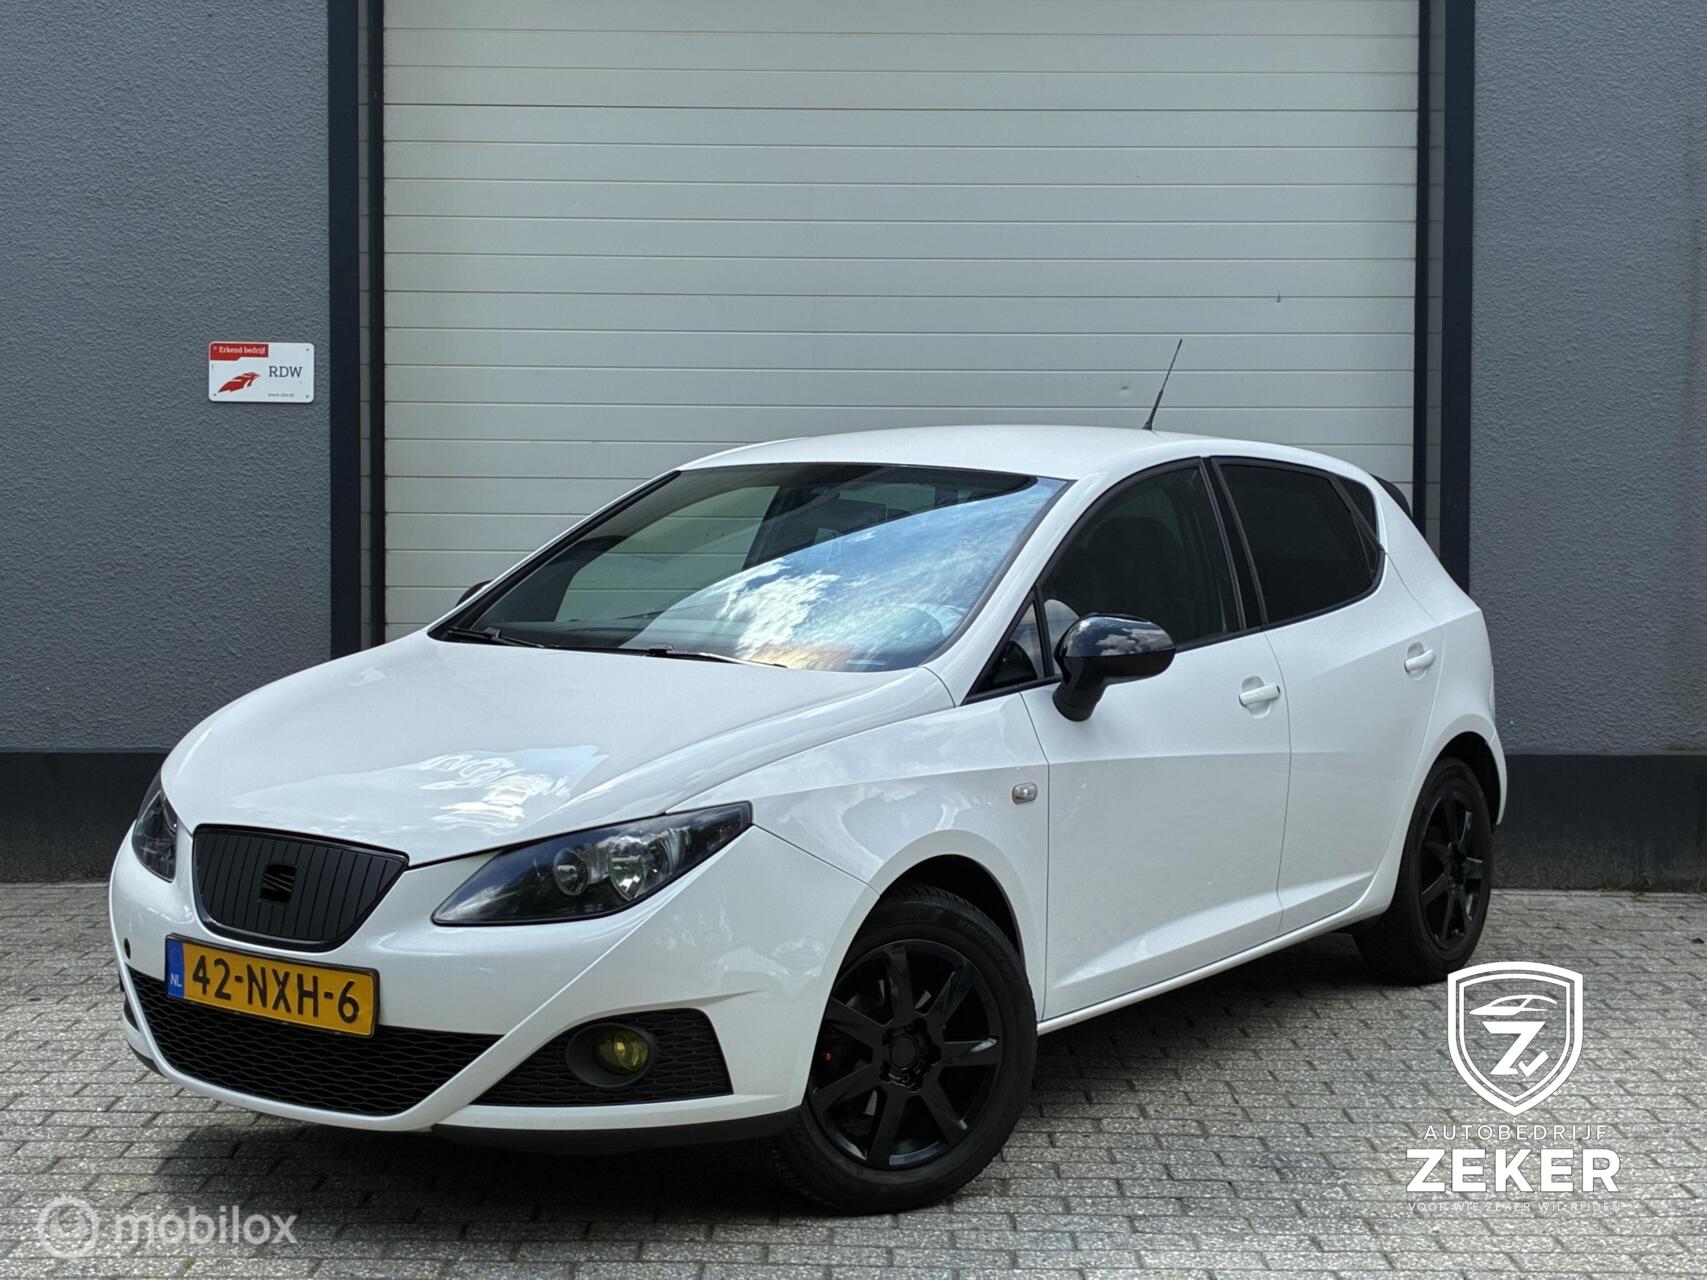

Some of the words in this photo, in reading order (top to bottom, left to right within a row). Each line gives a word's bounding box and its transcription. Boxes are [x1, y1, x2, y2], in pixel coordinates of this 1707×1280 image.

[219, 346, 243, 354] Erkend
[244, 346, 266, 355] bedrijf
[268, 365, 303, 378] RDW
[170, 972, 182, 988] NL
[192, 954, 360, 1024] 42-NXH-6
